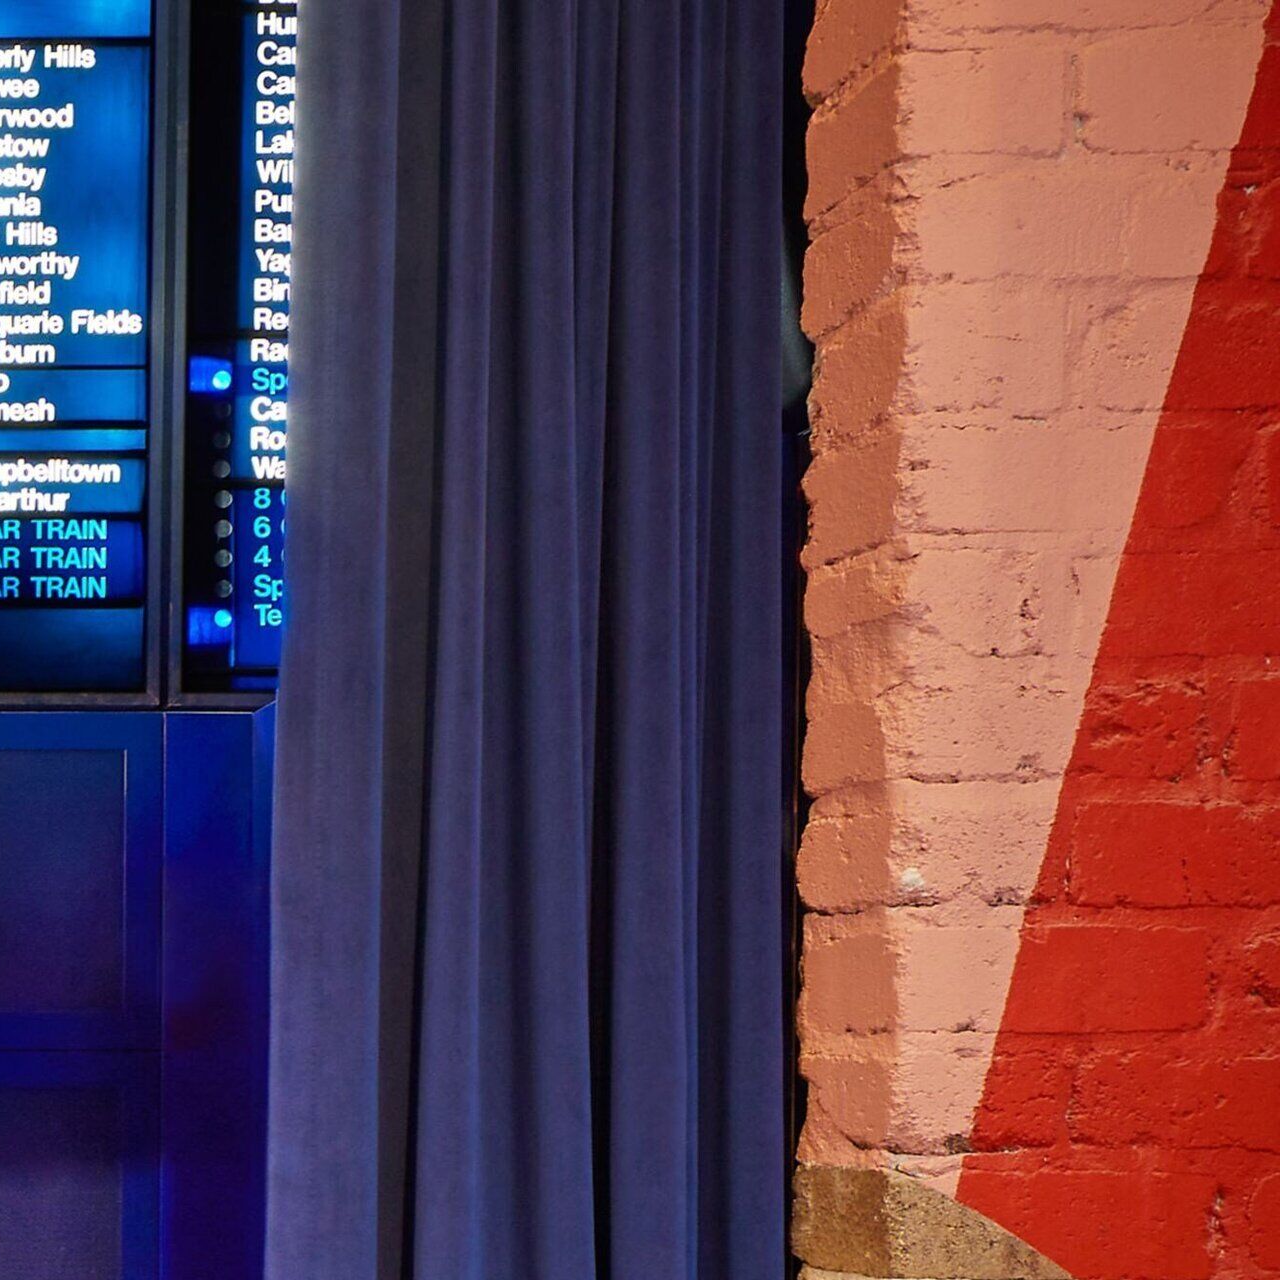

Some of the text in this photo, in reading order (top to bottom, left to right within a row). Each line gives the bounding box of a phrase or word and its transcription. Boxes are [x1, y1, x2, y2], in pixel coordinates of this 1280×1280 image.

[43, 44, 97, 69] Hills
[5, 221, 58, 247] Hills
[70, 308, 143, 335] Fields
[252, 487, 272, 510] 8
[30, 519, 108, 540] TRAIN
[252, 515, 272, 539] 6
[30, 546, 107, 569] TRAIN
[252, 544, 272, 568] 4
[30, 576, 107, 599] TRAIN
